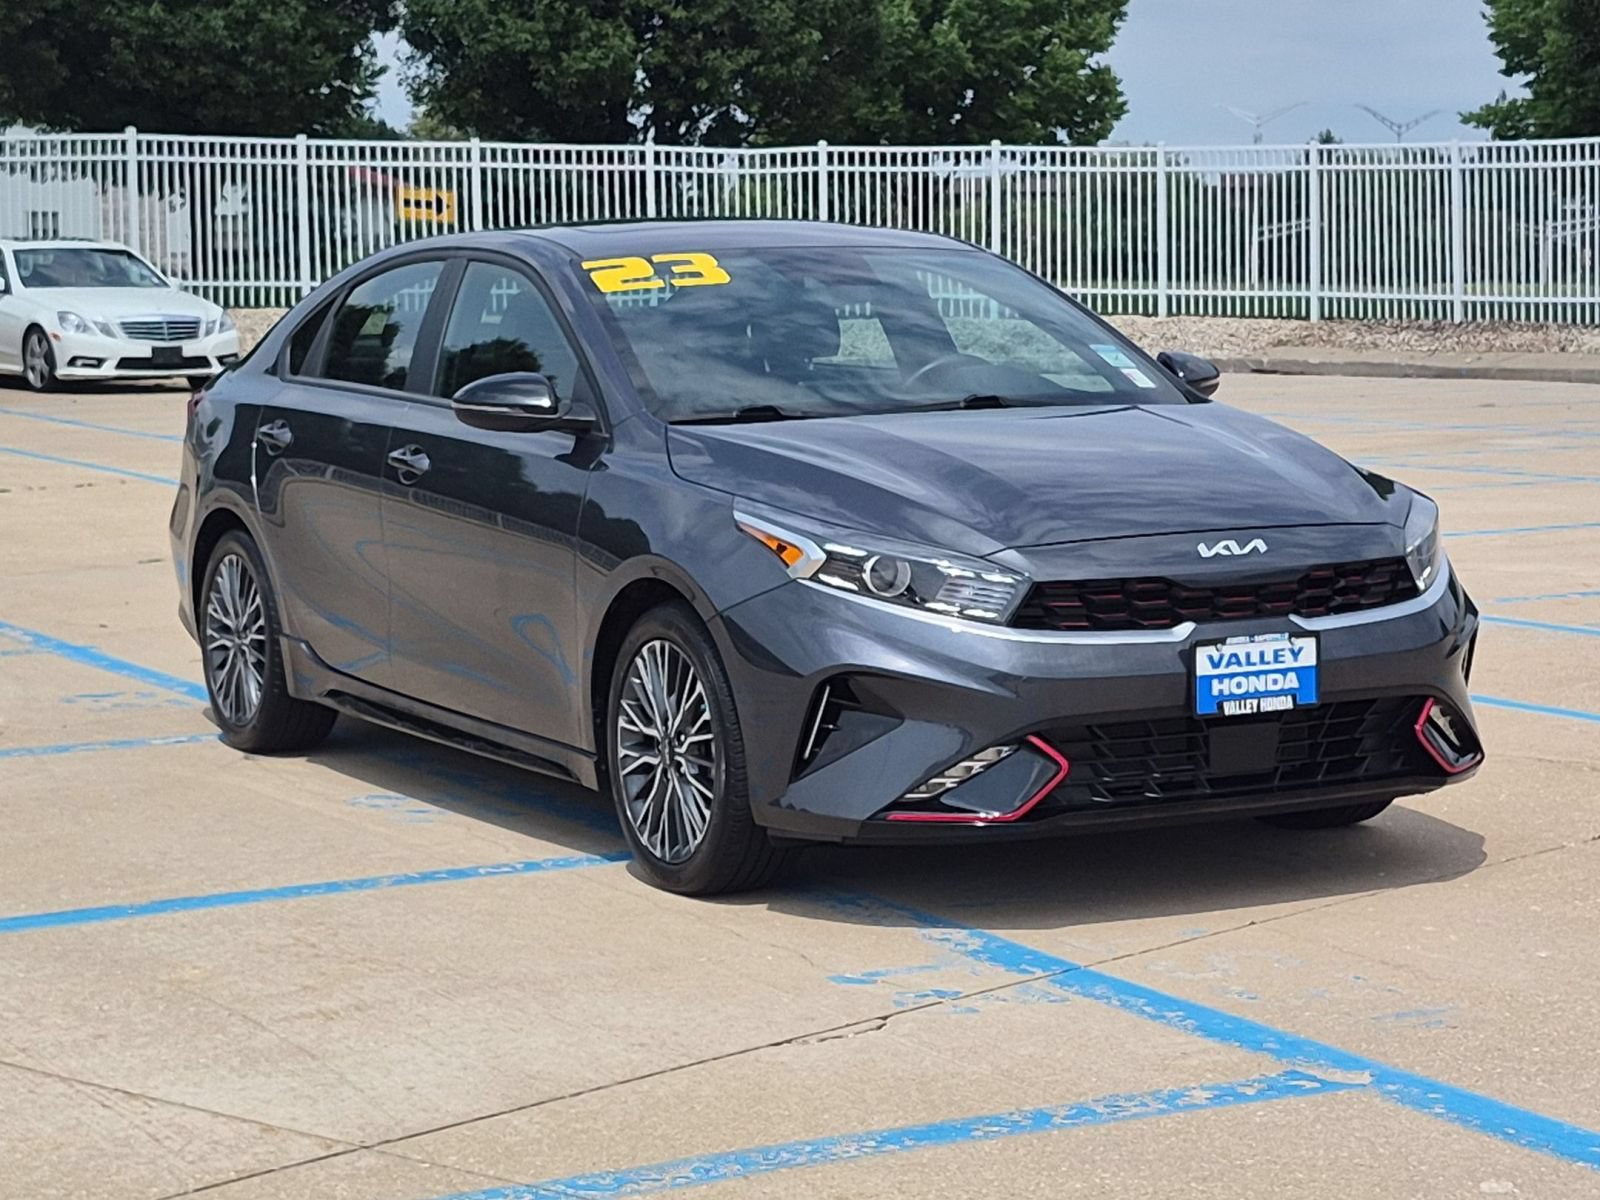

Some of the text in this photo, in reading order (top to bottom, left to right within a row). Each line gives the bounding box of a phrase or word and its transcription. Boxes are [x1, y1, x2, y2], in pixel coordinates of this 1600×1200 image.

[581, 252, 732, 293] 23
[1197, 538, 1268, 558] KIA
[1207, 646, 1304, 670] VALLEY
[1211, 671, 1299, 697] HONDA
[1223, 695, 1294, 716] VALLEY HONDA
